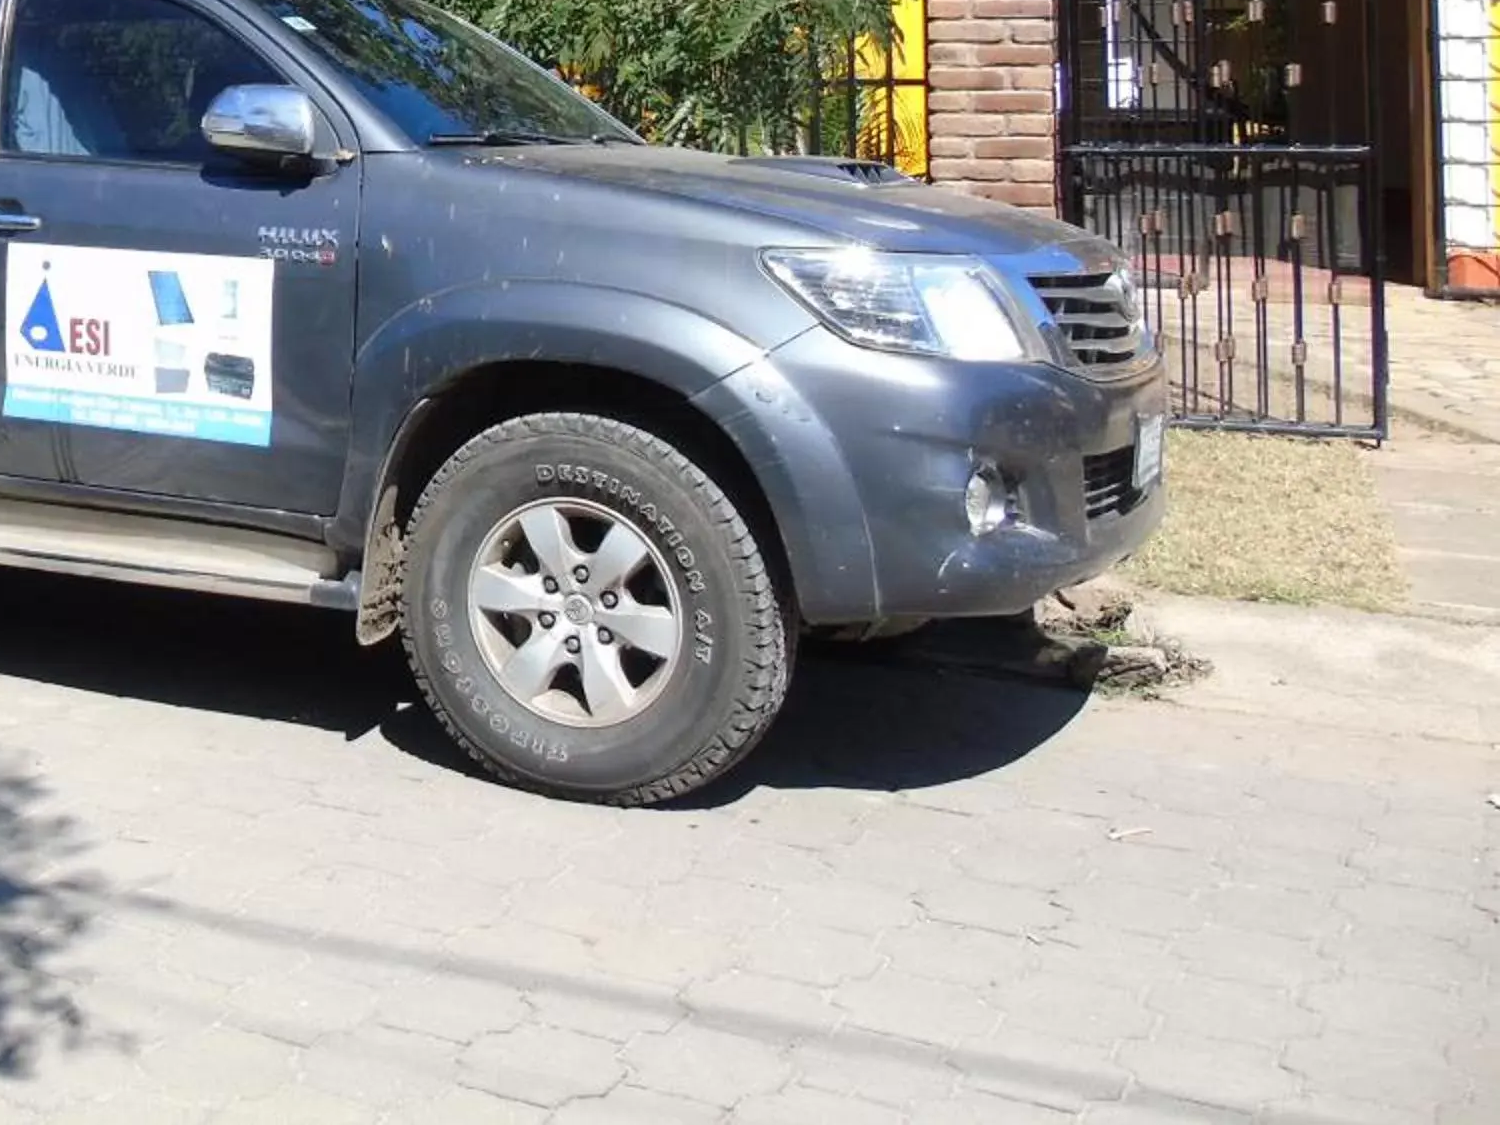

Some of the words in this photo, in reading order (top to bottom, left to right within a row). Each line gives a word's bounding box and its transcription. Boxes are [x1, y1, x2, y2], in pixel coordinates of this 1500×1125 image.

[257, 227, 339, 249] HILUX
[536, 464, 705, 592] DESTINATION
[695, 608, 714, 665] A/T
